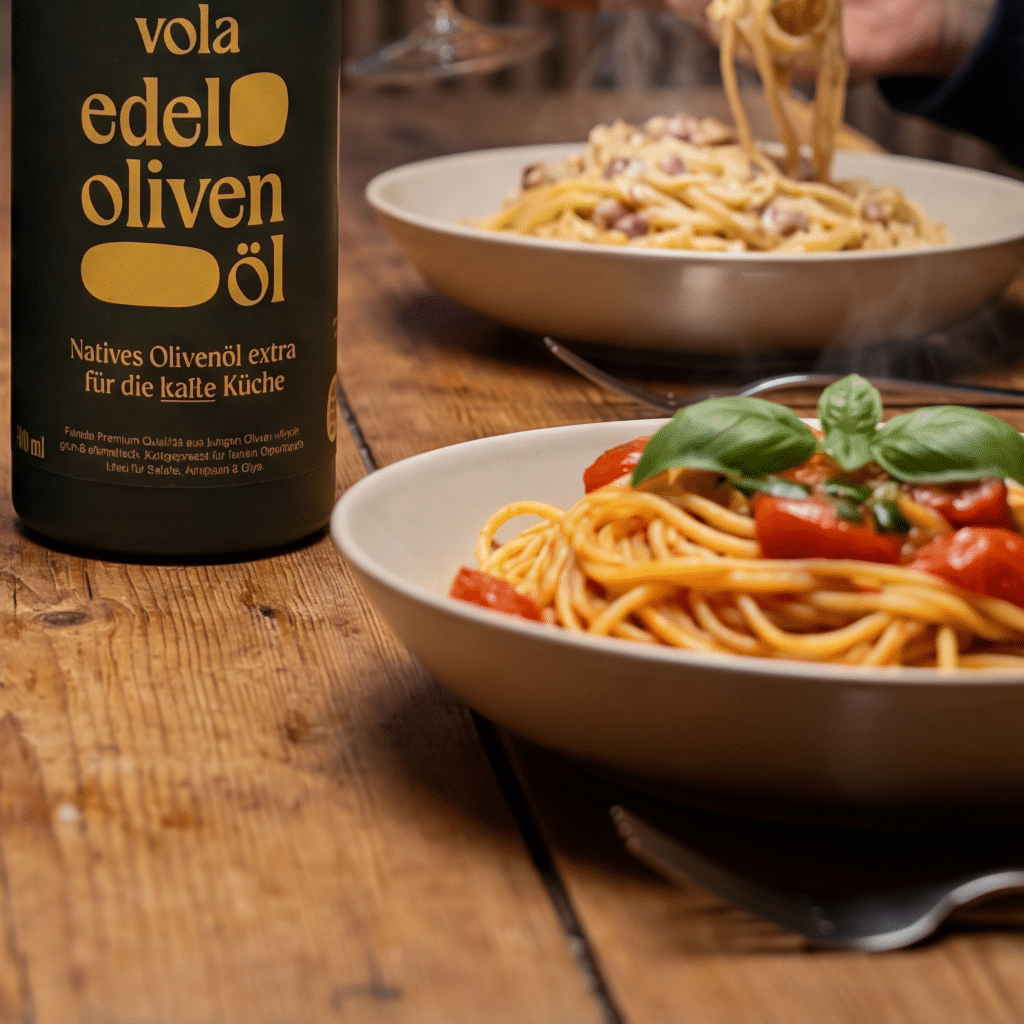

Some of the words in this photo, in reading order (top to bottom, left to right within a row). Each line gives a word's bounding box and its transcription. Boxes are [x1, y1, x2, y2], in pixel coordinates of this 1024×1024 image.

[134, 4, 240, 55] vola
[81, 76, 223, 148] edel
[81, 159, 284, 229] oliven
[227, 234, 285, 307] öl
[70, 337, 144, 367] Natives
[149, 343, 242, 368] Olivenöl
[248, 342, 296, 365] extra
[85, 369, 116, 394] für
[121, 374, 154, 398] die
[223, 370, 286, 397] Küche
[97, 431, 140, 446] Premium
